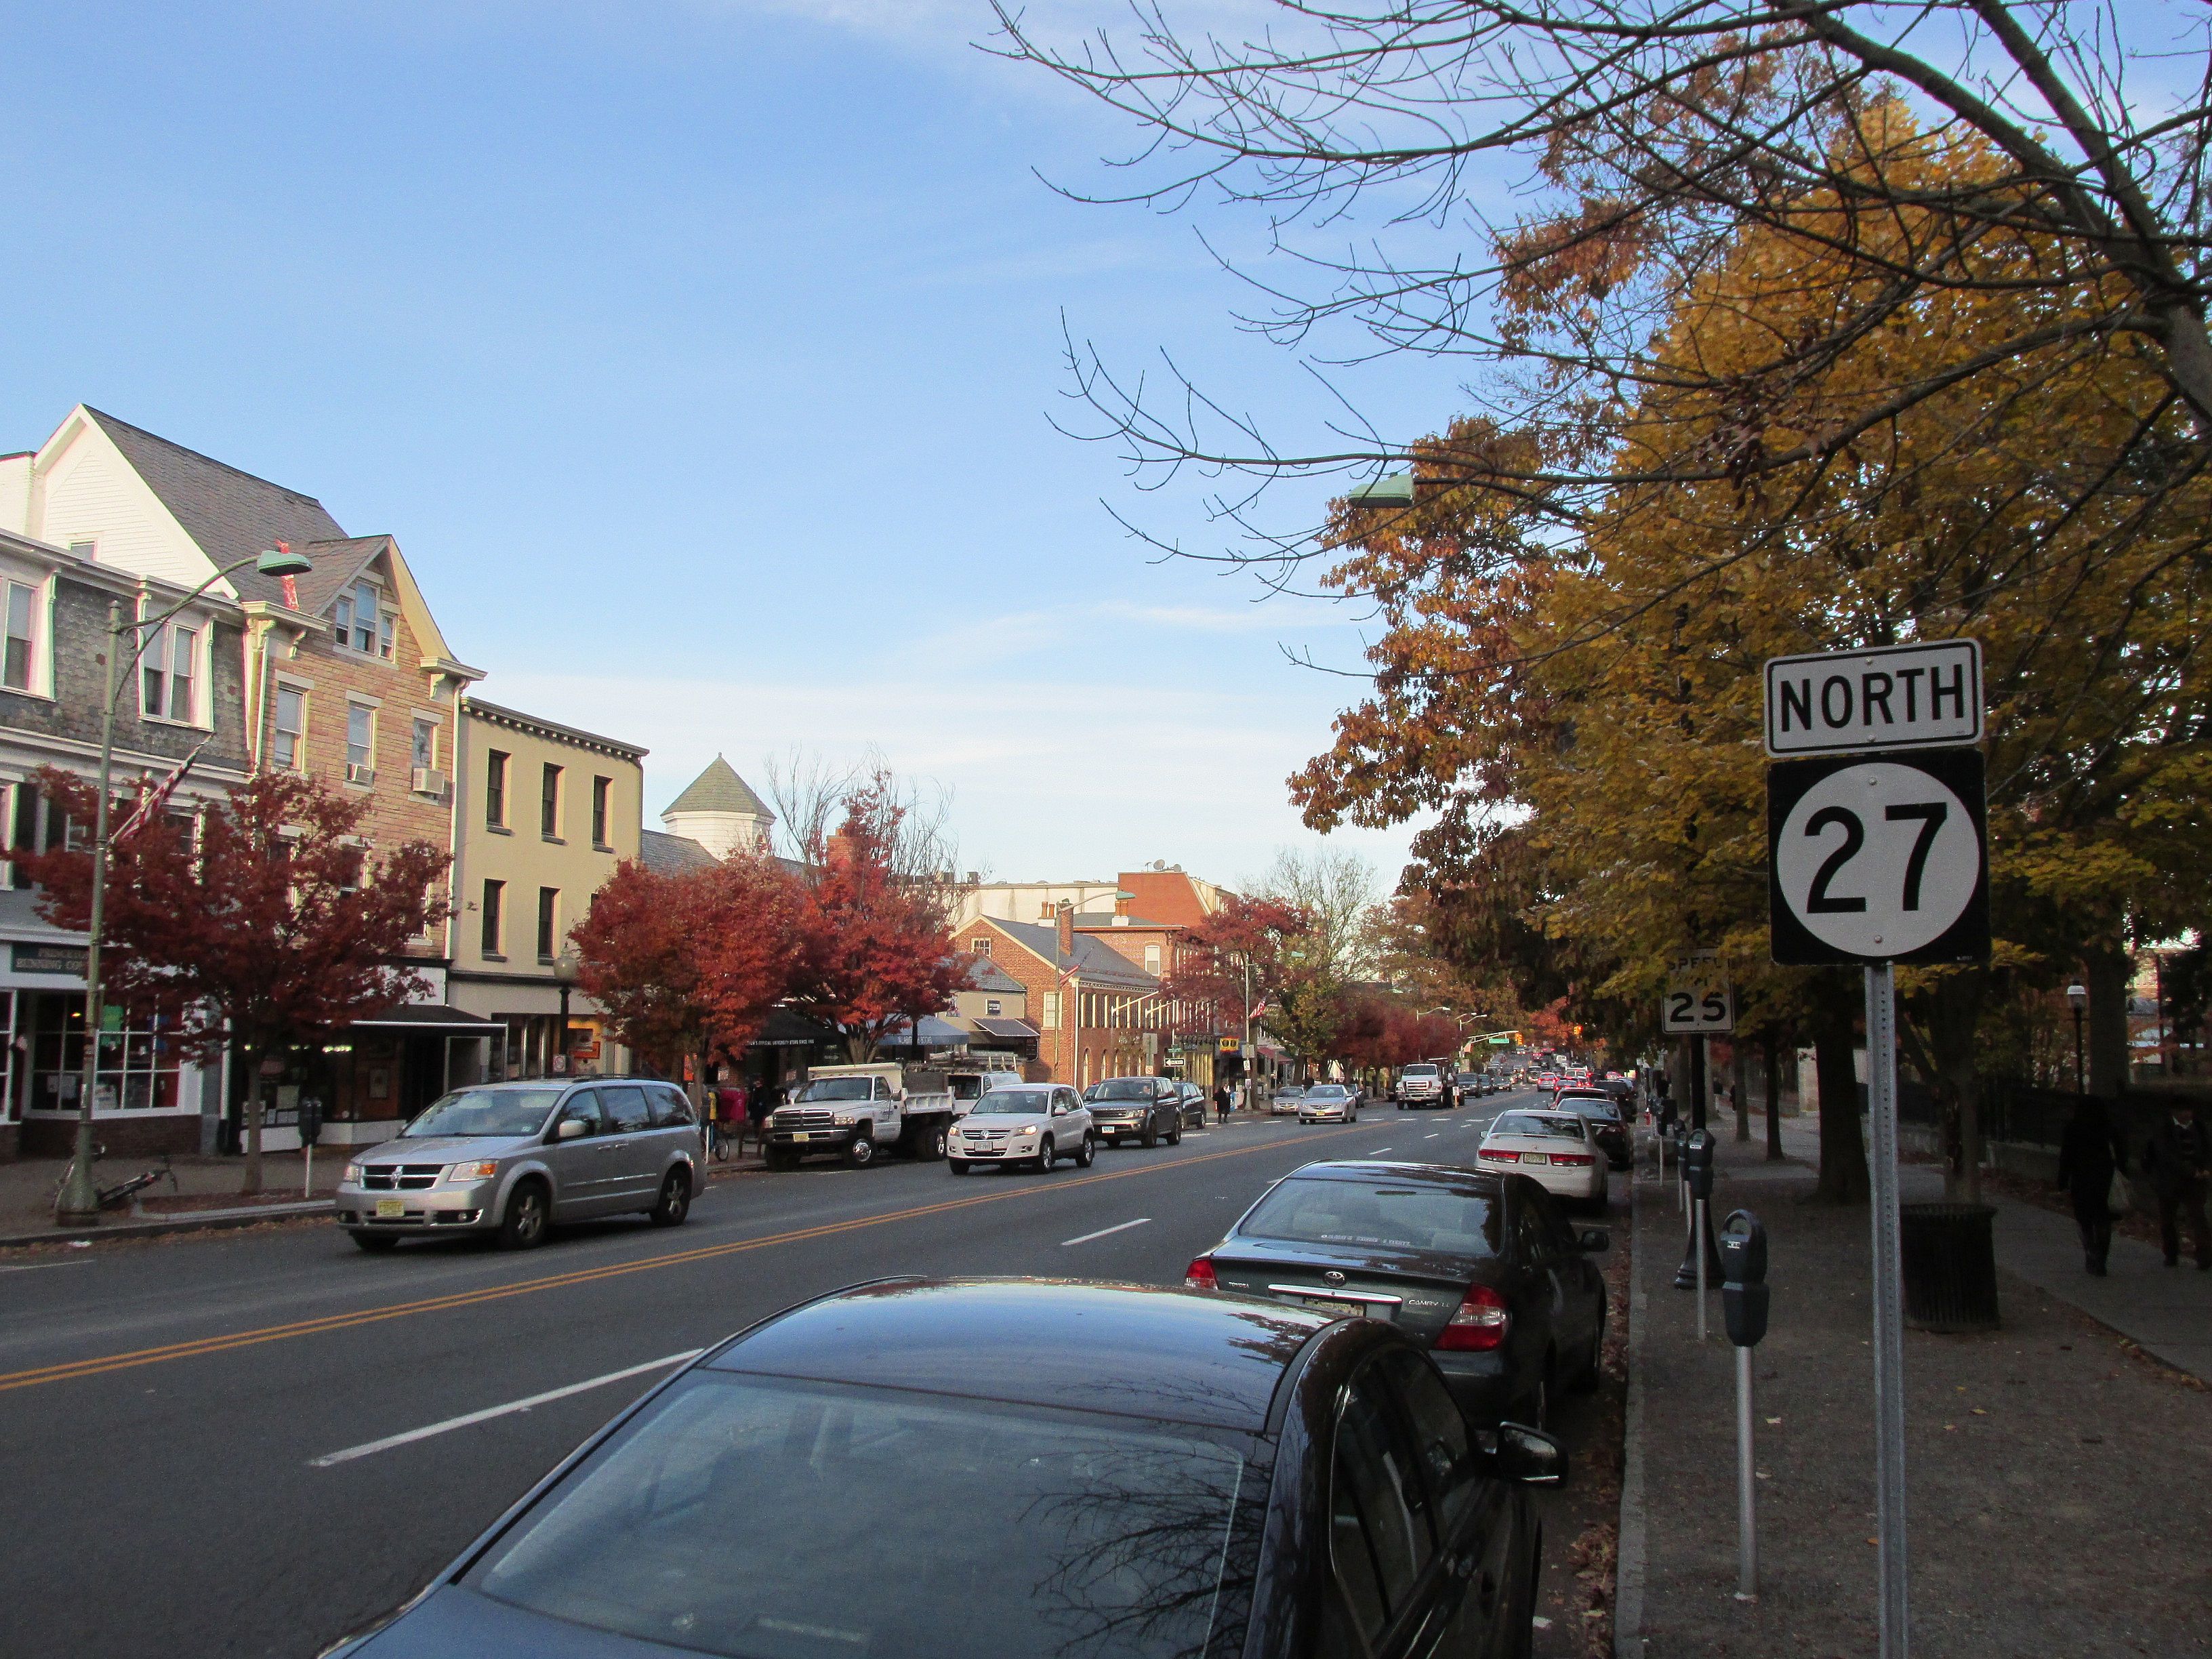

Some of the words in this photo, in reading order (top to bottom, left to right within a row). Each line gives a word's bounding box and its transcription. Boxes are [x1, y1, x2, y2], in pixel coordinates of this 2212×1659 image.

[1781, 664, 1964, 732] NORTH
[1805, 802, 1948, 914] 27
[1671, 991, 1726, 1022] 25
